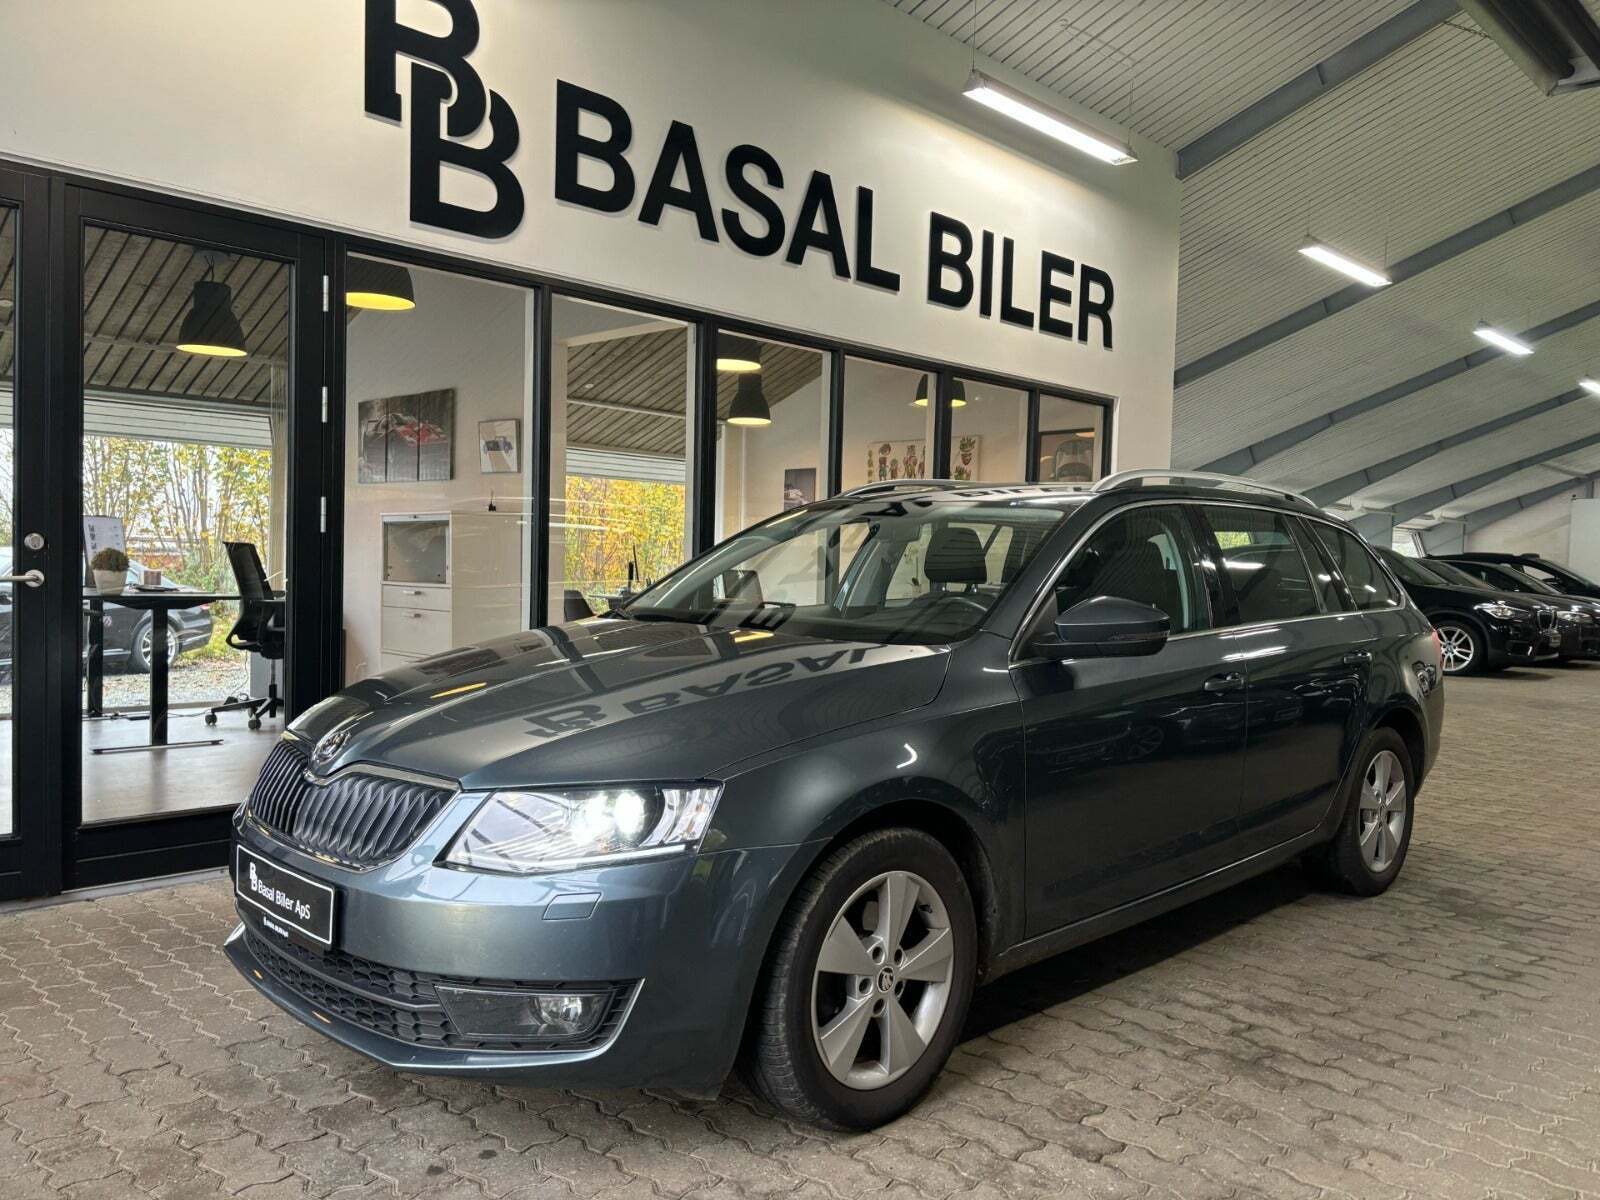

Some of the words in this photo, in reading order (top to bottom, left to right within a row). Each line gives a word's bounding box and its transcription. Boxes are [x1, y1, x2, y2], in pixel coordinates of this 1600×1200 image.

[554, 79, 901, 292] BASAL
[927, 212, 1114, 349] BILER
[258, 879, 275, 902] Basal
[275, 889, 295, 911] Biler
[295, 899, 311, 920] ApS
